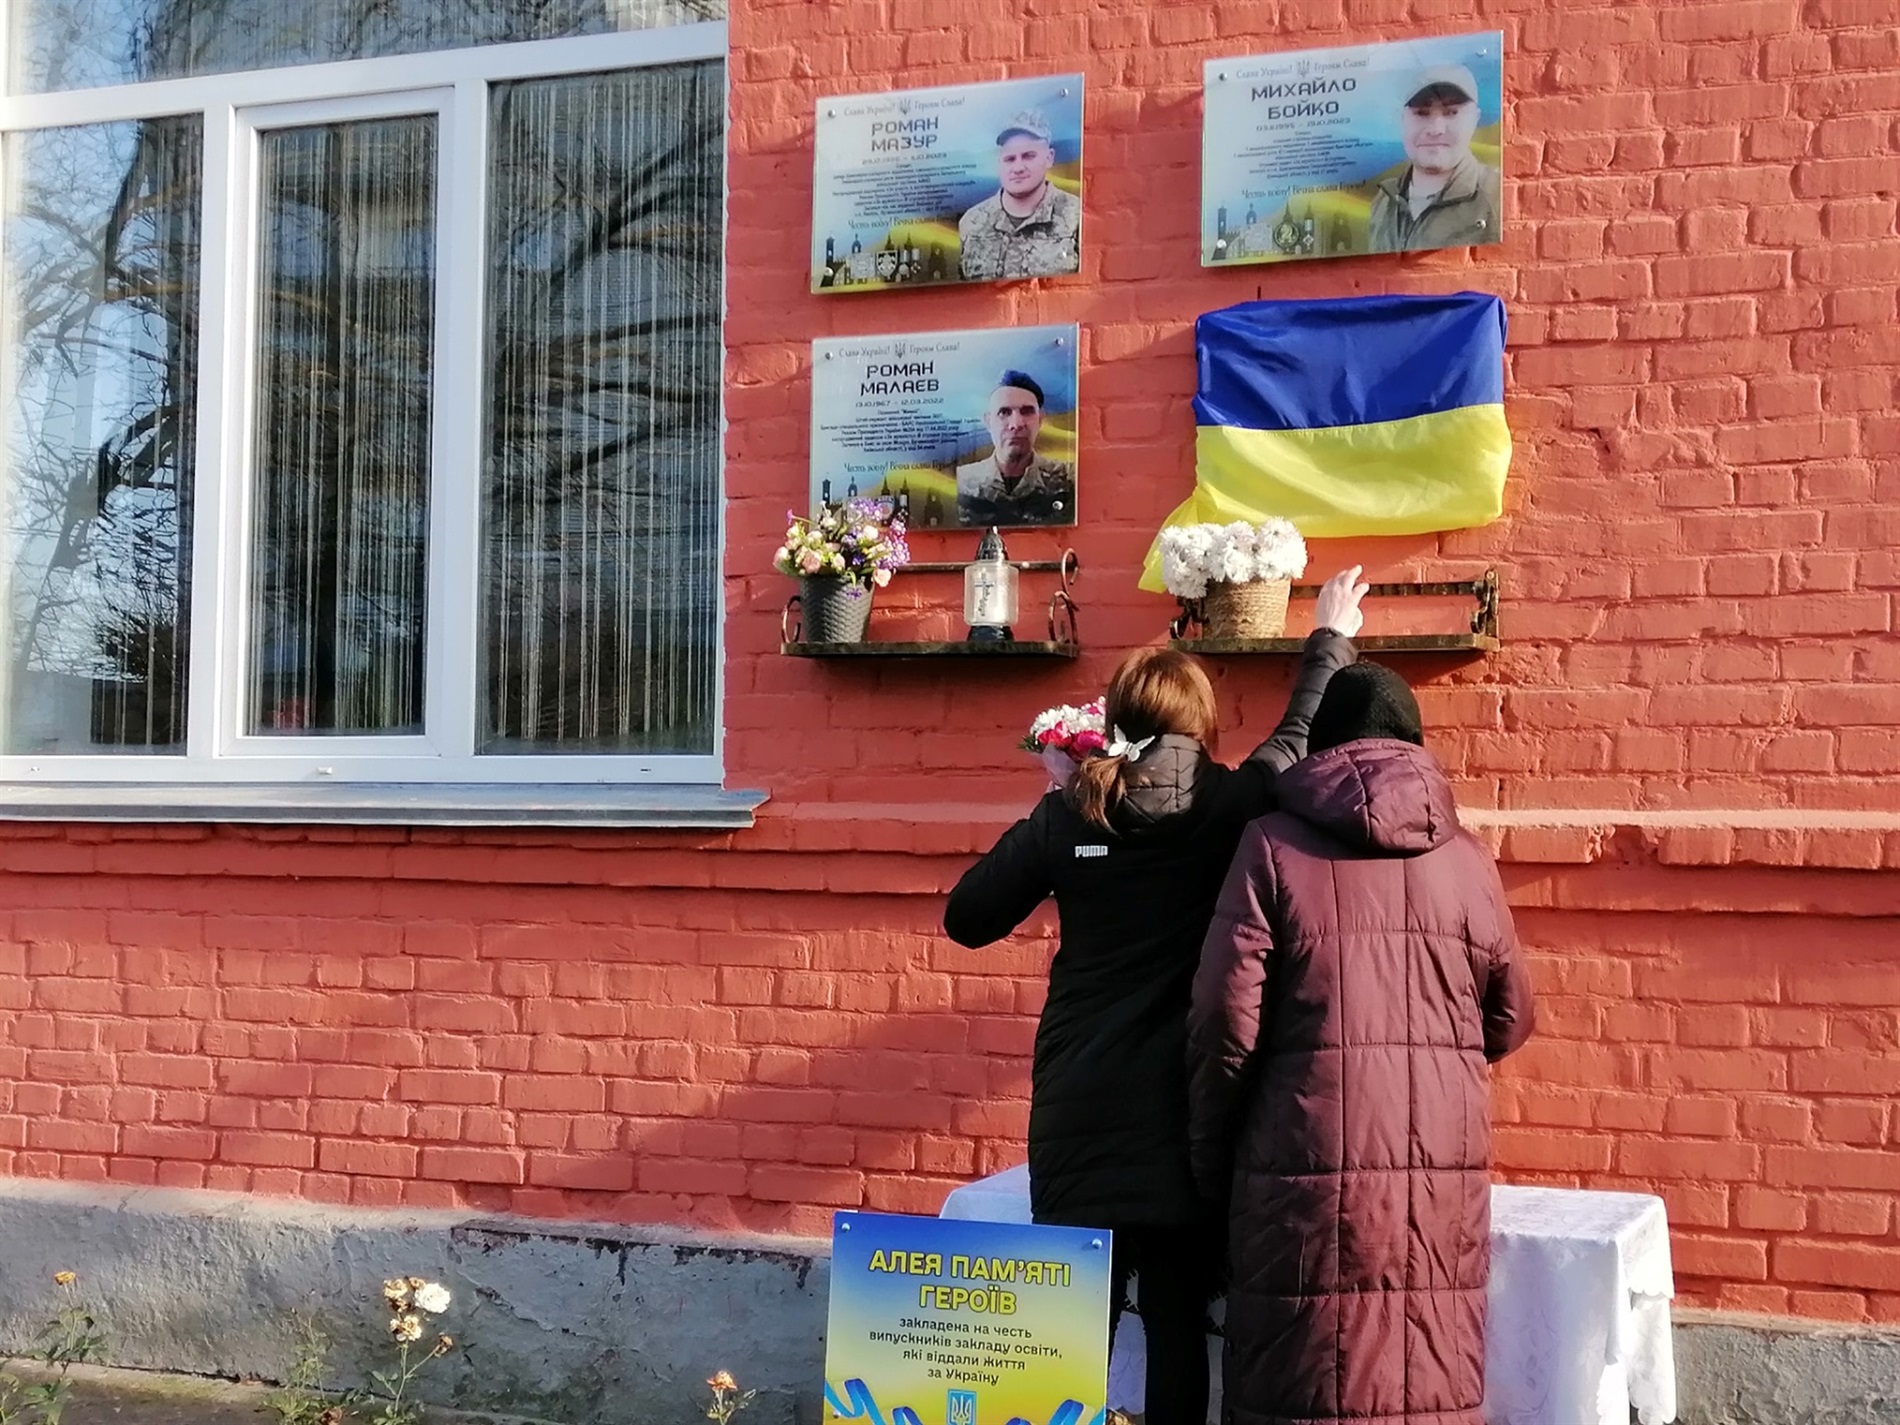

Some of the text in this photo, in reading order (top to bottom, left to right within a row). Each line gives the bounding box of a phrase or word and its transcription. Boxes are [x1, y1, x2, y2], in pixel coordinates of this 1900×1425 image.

[1251, 76, 1357, 102] МИХАЙЛО
[1268, 99, 1340, 120] БОЙКО
[871, 115, 939, 137] РОМАН
[871, 134, 938, 152] МАЗУР
[866, 360, 934, 380] РОМАН
[1074, 845, 1108, 858] PUMA
[868, 1249, 1071, 1287] АЛЕЯ ПАМ’ЯТІ
[918, 1284, 1017, 1315] ГЕРОЇВ
[899, 1317, 1033, 1339] закладена на честь
[869, 1330, 1063, 1360] випускників закладу освіти,
[903, 1349, 1026, 1371] які віддали життя
[927, 1368, 1000, 1386] за Україну
